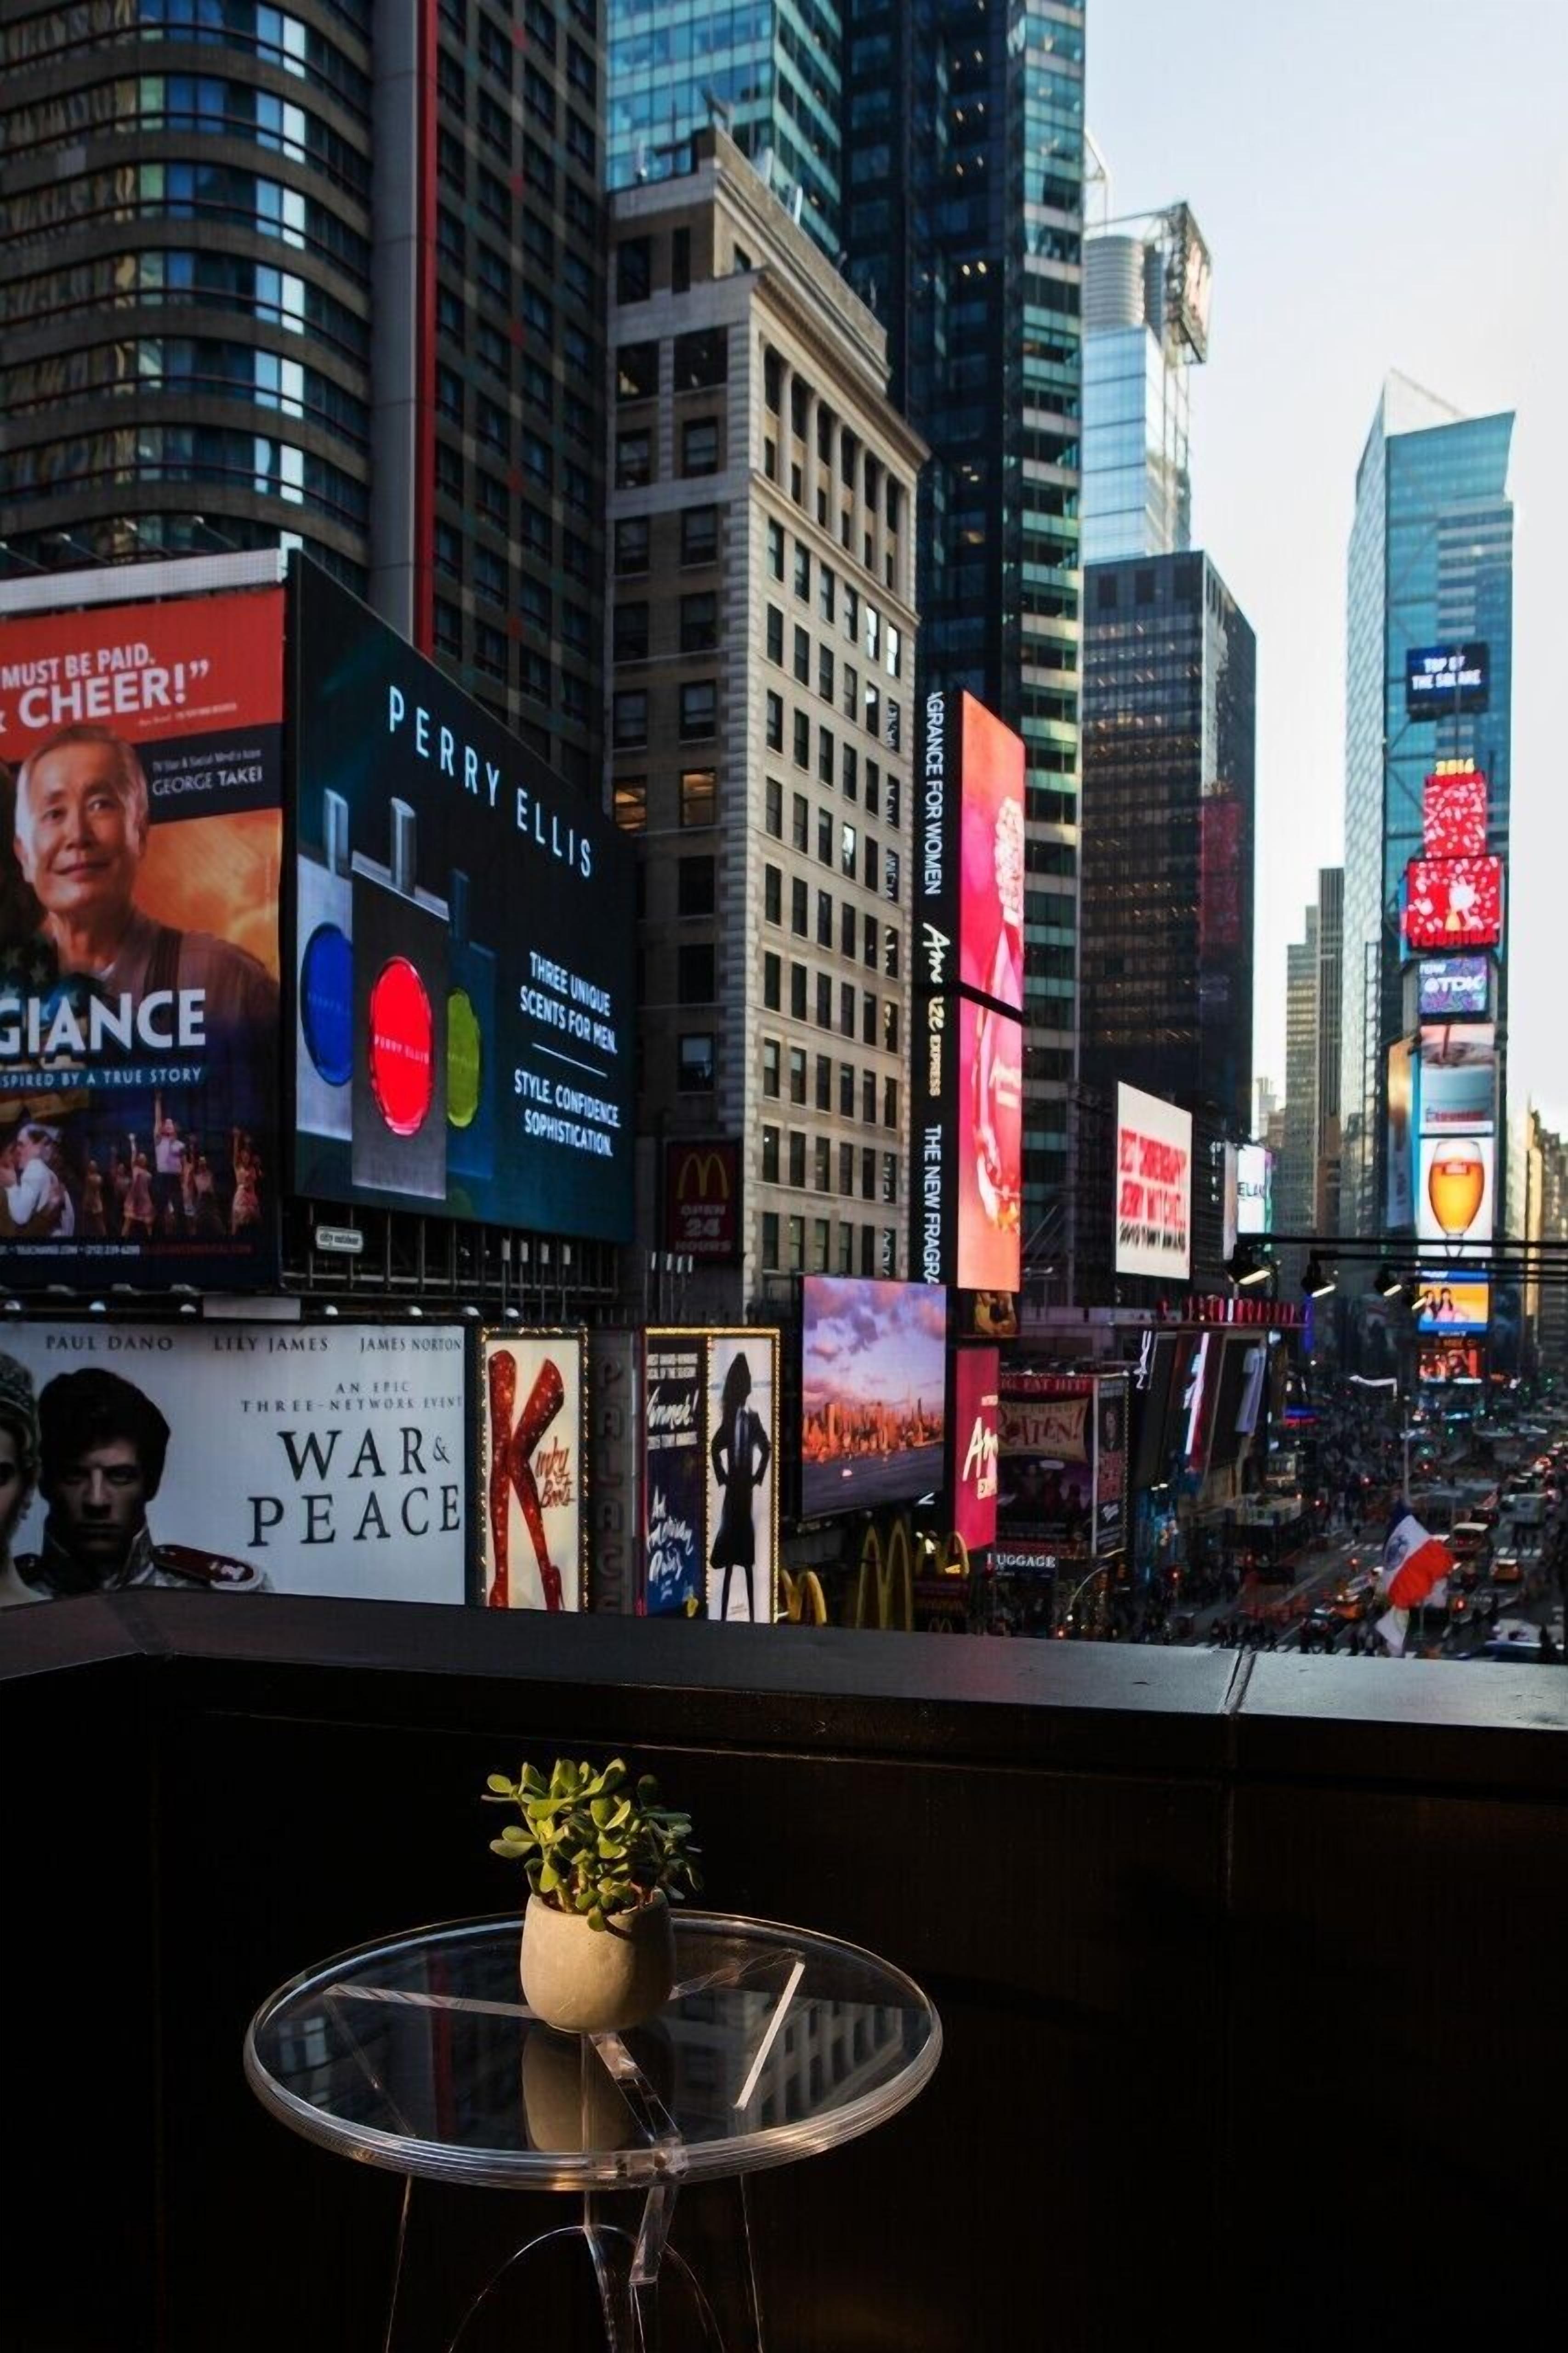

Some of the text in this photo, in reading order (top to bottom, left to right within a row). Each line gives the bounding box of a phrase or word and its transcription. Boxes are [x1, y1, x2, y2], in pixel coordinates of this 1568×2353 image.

[2, 643, 155, 688] MUST BE PAID.
[152, 766, 262, 796] GEORGE TAKEI
[389, 685, 591, 877] PERRY ELLIS
[925, 780, 943, 820] FOR
[924, 821, 943, 895] WOMEN
[529, 951, 610, 1017] THREE UNIQUE
[520, 985, 566, 1030] SCENTS
[568, 1010, 591, 1042] FOR
[62, 1073, 79, 1086] BY
[86, 1072, 96, 1084] A
[103, 1069, 142, 1084] TRUE
[150, 1067, 202, 1082] STORY
[924, 1124, 942, 1162] THE
[924, 1166, 941, 1209] NEW
[46, 1335, 173, 1351] PAUL DANO
[214, 1337, 328, 1353] LILY JAMES
[360, 1338, 462, 1353] JAMES NORTON
[241, 1396, 463, 1413] THREE-NETWORK EVENT
[335, 1381, 412, 1394] AN EPIC
[277, 1427, 451, 1482] WAR &
[247, 1484, 460, 1547] PEACE
